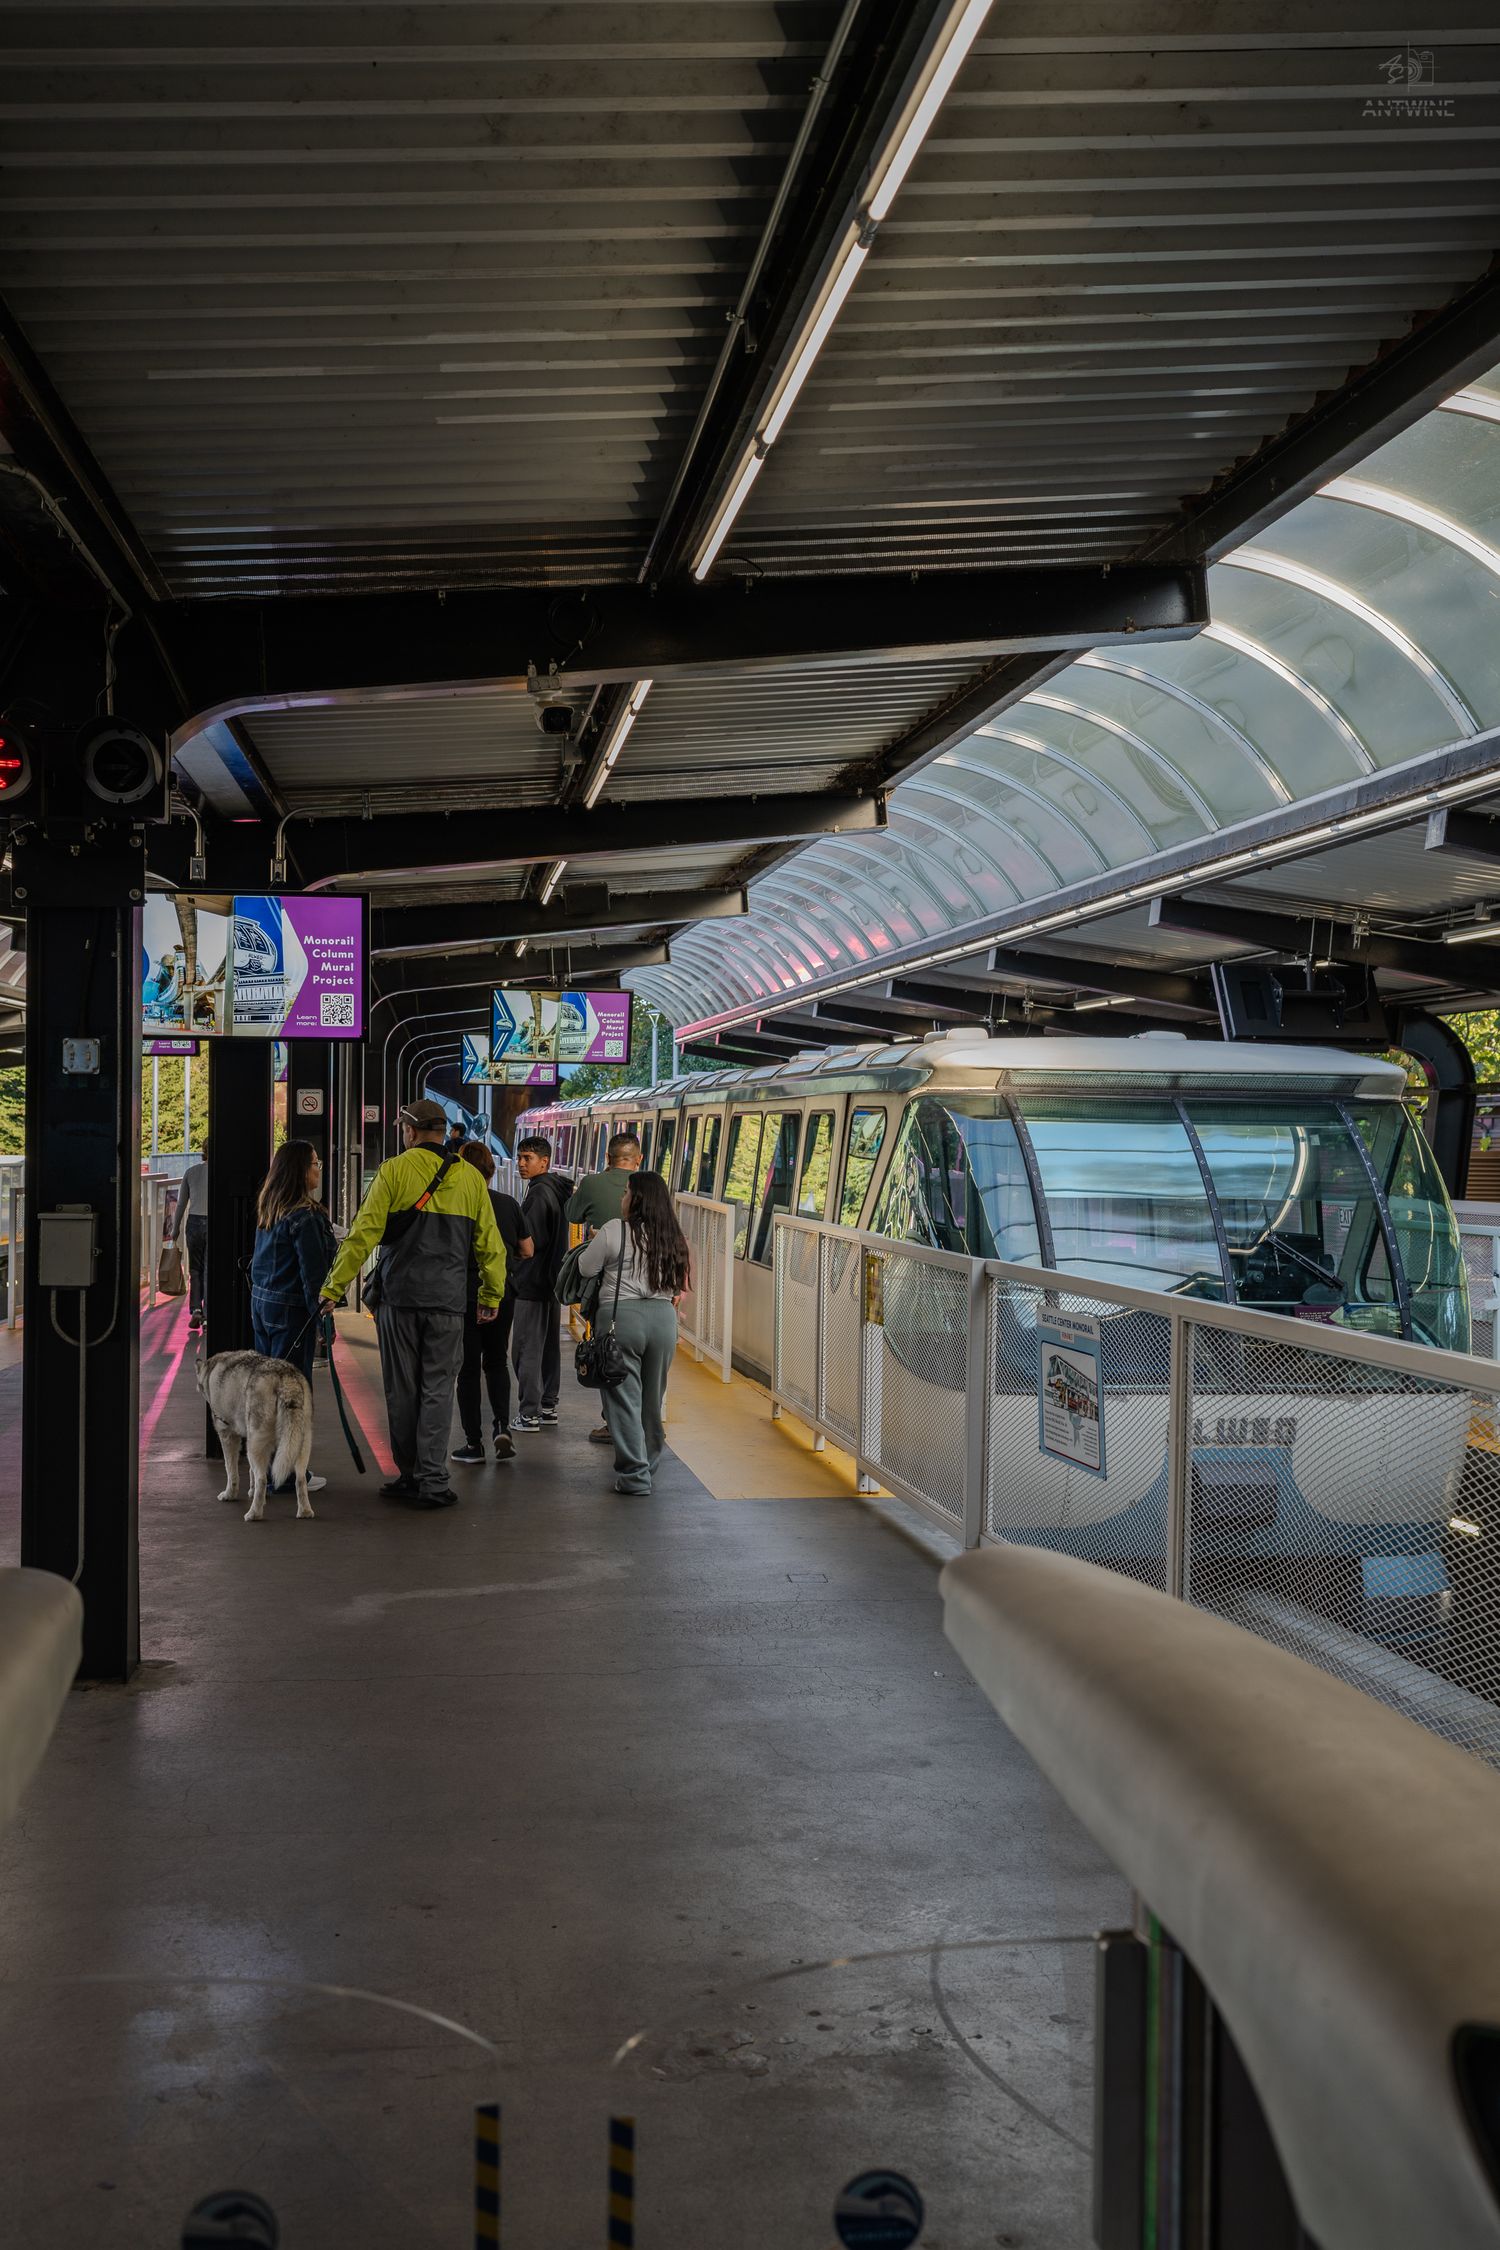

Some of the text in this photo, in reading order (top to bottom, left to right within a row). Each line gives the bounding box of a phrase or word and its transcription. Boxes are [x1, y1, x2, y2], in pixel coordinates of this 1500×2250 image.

[303, 935, 354, 945] Monorail
[312, 949, 354, 959] Column
[321, 962, 354, 971] Mural
[312, 975, 354, 986] Project
[1041, 1313, 1094, 1335] SEATTLE CENTER MONORAIL
